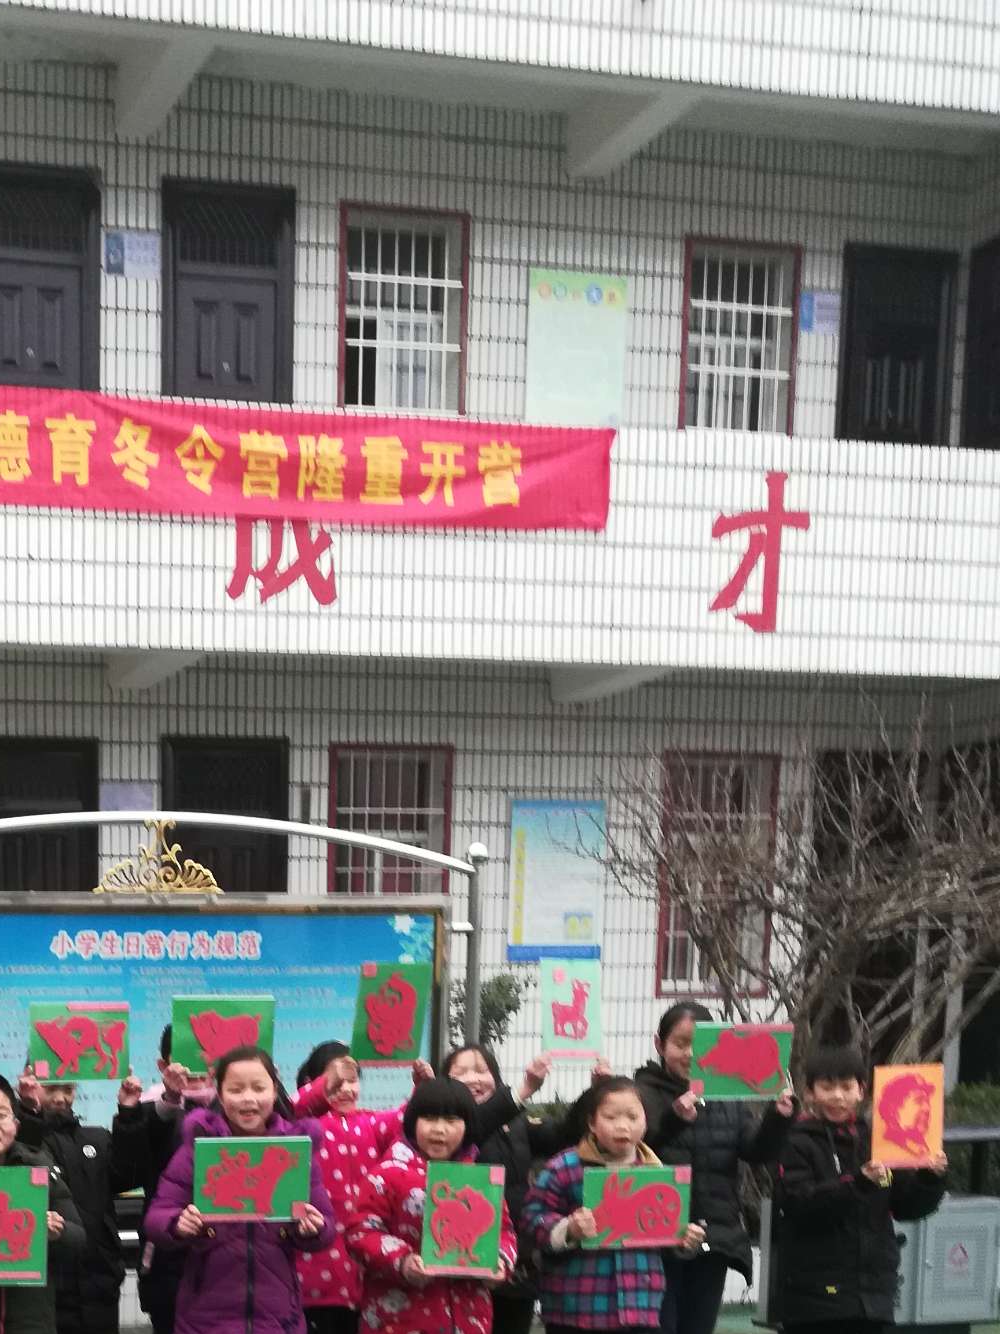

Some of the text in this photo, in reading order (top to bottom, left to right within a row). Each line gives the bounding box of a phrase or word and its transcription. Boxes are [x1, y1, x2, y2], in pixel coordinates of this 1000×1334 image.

[709, 471, 810, 633] 才
[50, 930, 262, 959] 小学生日常行为规范
